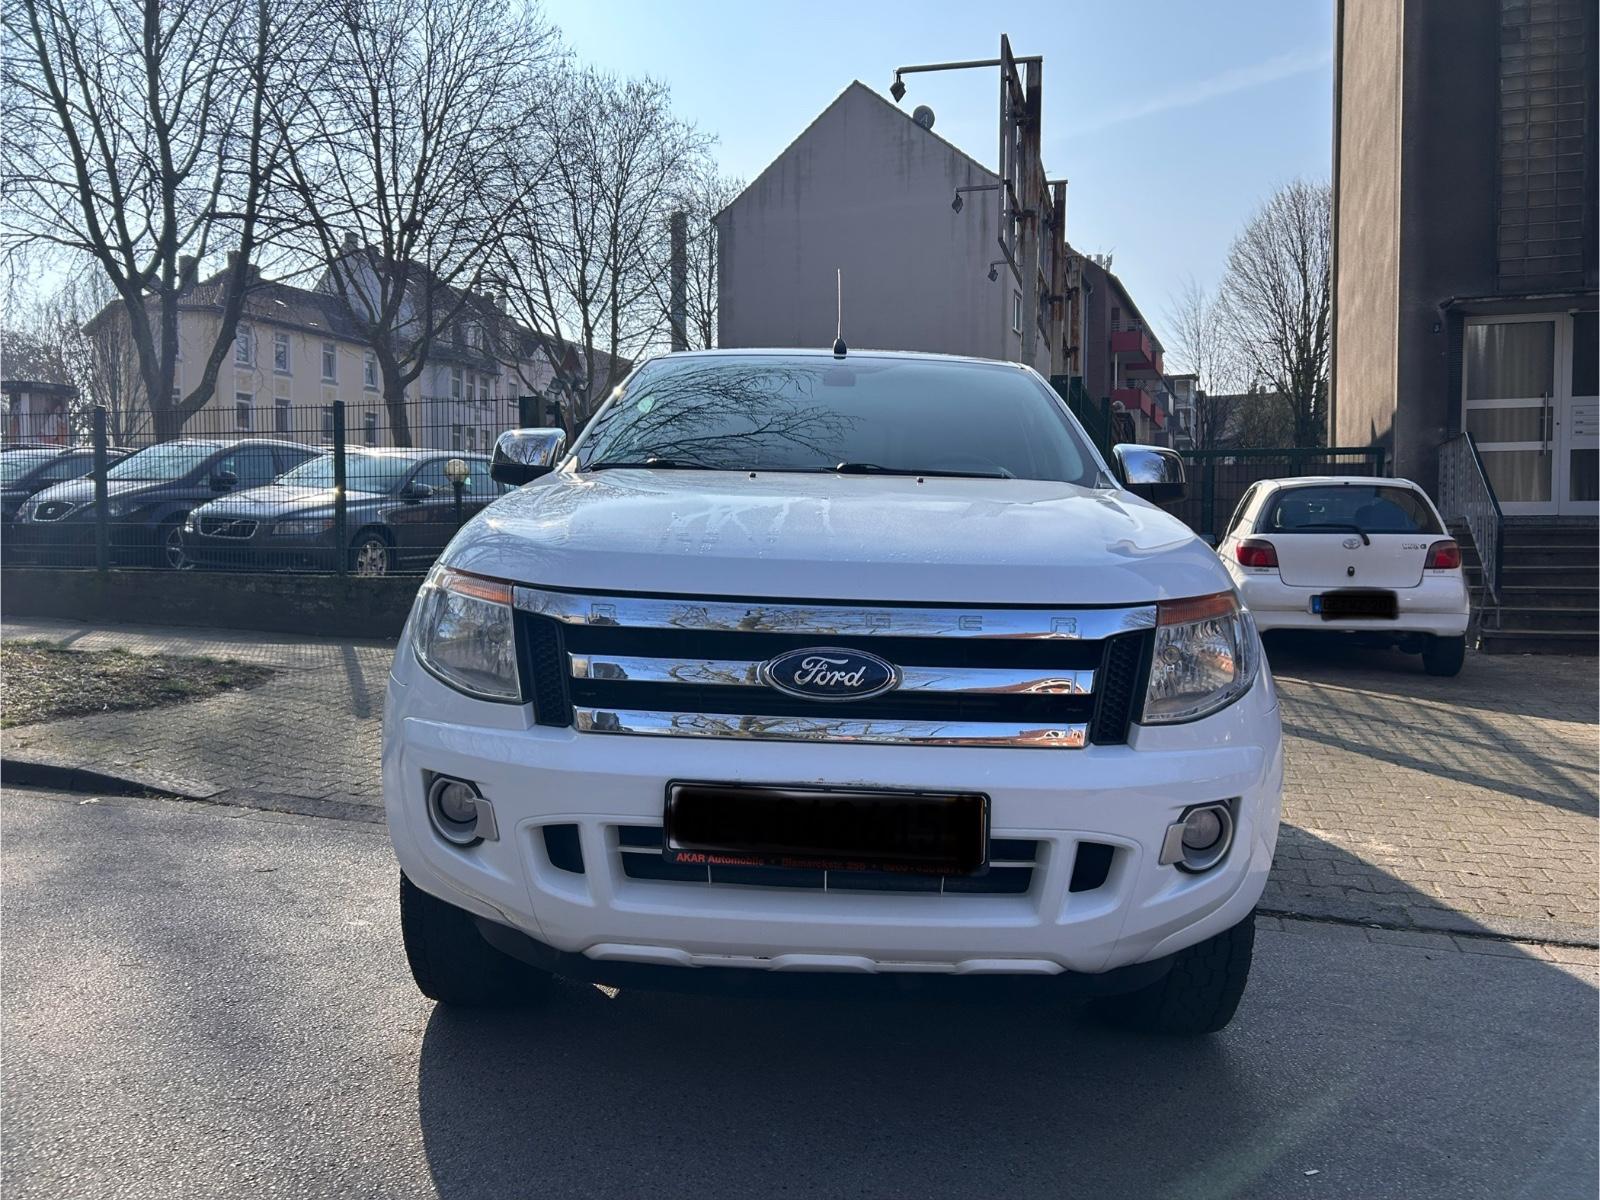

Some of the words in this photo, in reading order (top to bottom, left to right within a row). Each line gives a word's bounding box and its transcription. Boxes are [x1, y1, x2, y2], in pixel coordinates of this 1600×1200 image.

[591, 603, 1077, 634] RANGER
[794, 656, 867, 687] Ford
[676, 852, 705, 863] AKAR
